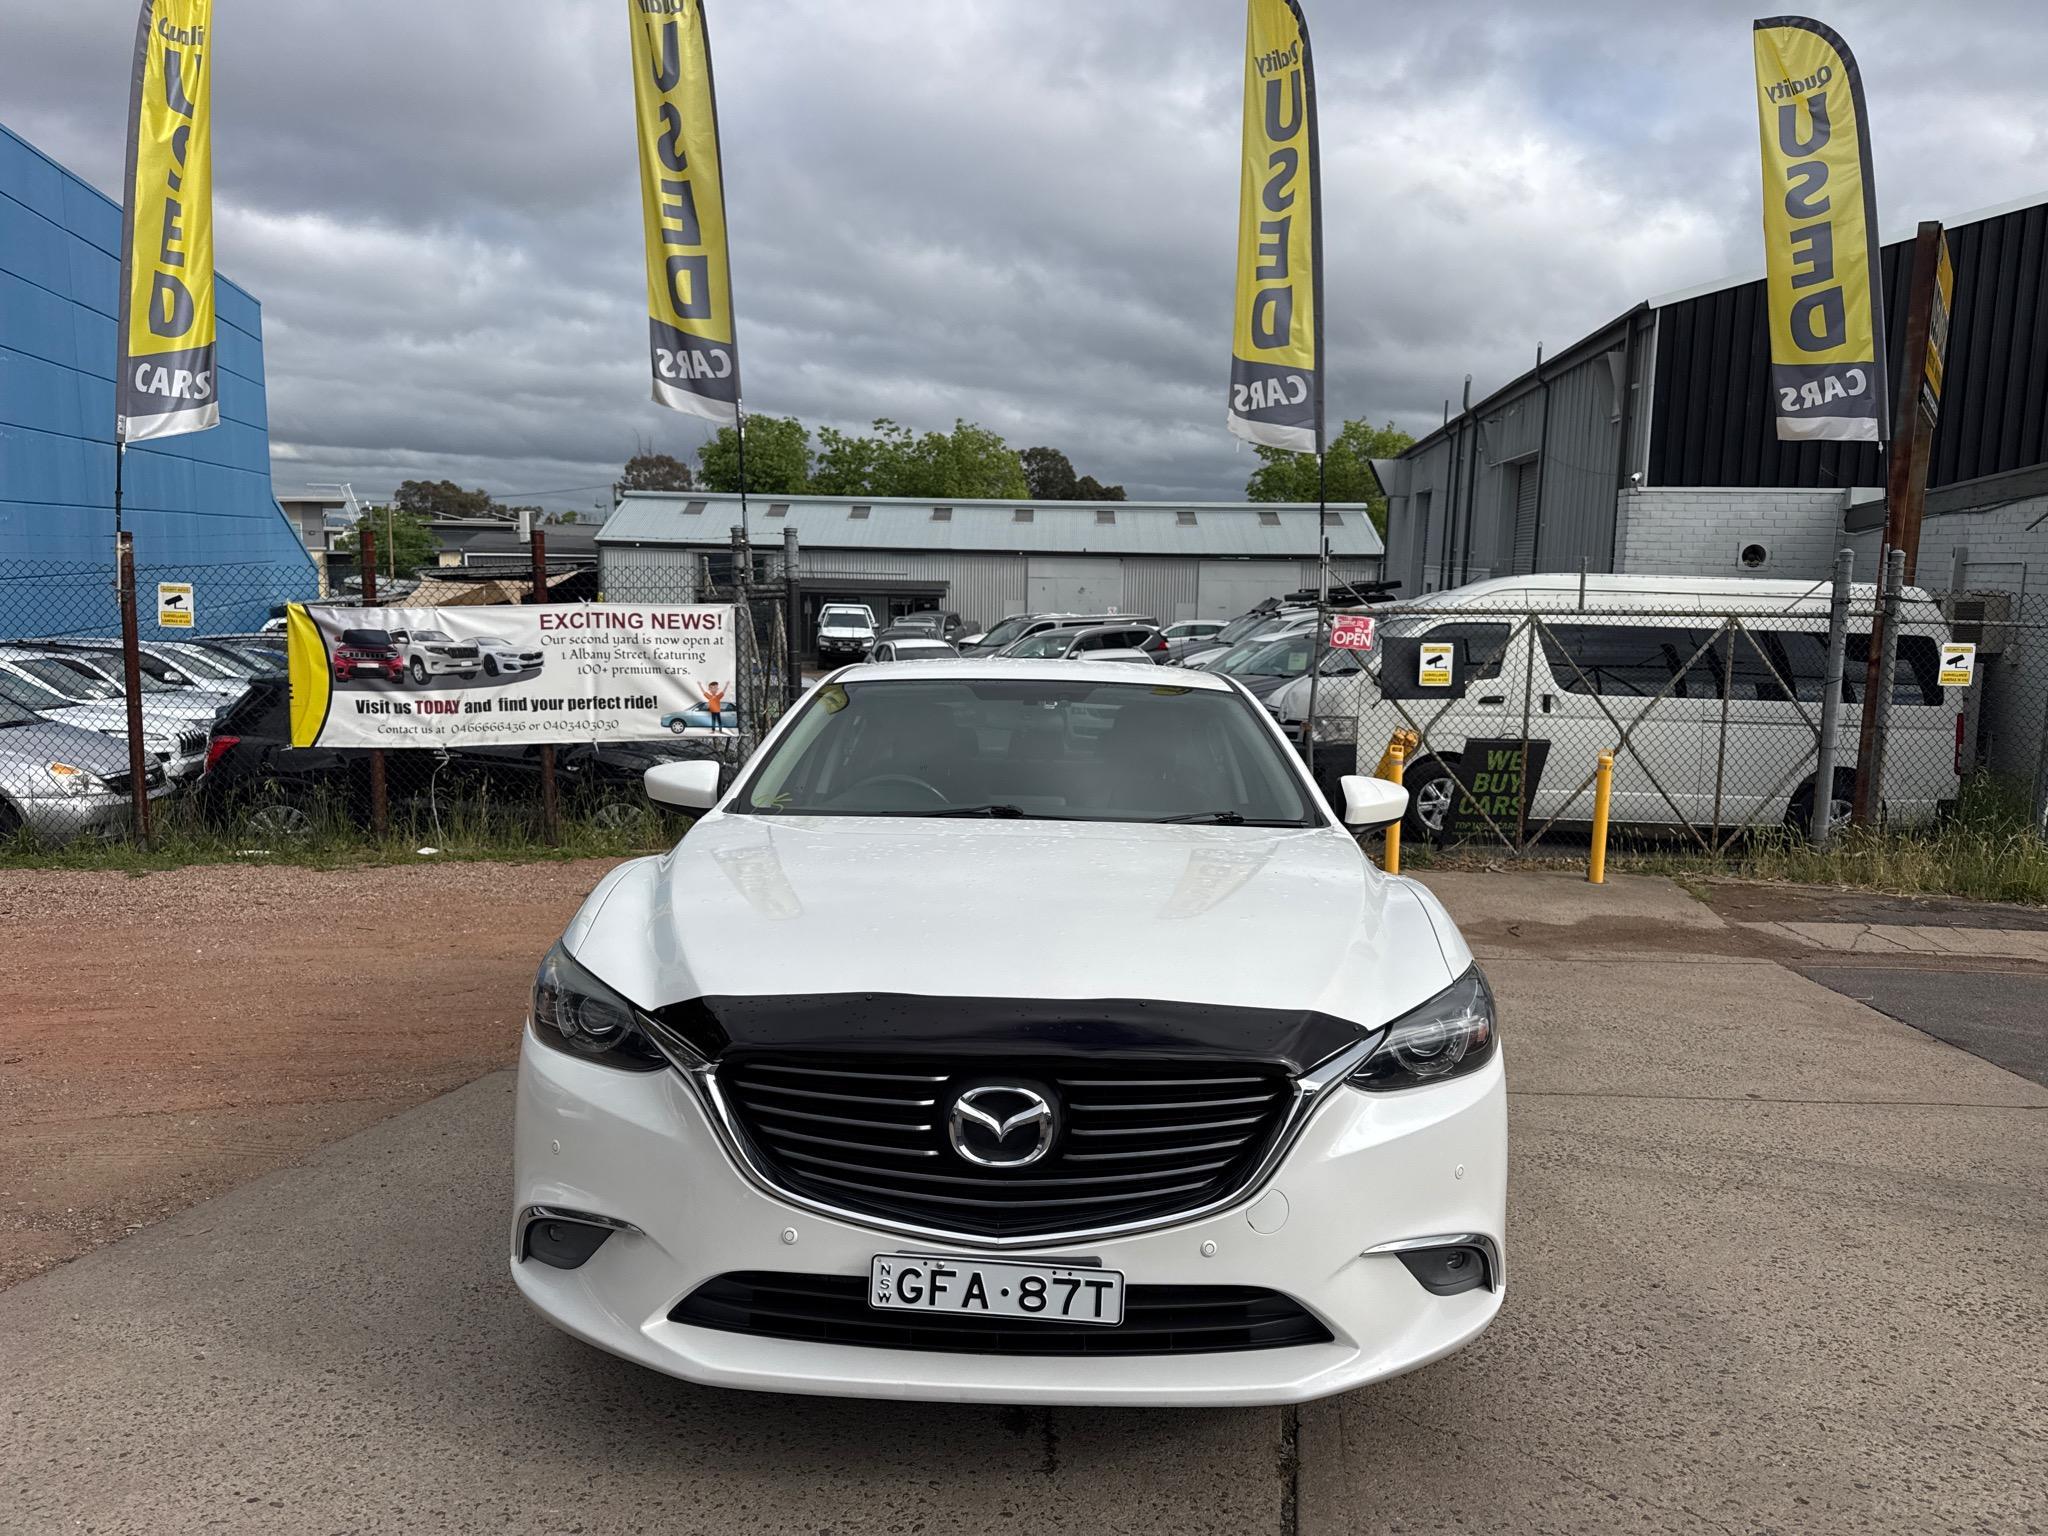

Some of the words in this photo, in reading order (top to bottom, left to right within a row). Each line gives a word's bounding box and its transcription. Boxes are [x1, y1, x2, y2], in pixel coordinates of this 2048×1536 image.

[134, 362, 212, 401] CARS
[539, 612, 644, 631] EXCITING
[651, 613, 723, 630] NEWS!
[540, 634, 566, 647] Our
[569, 633, 609, 645] second
[612, 633, 639, 648] yard
[642, 633, 652, 645] is
[655, 635, 680, 646] now
[683, 635, 710, 650] open
[713, 635, 725, 646] at
[1333, 630, 1372, 647] OPEN
[561, 651, 566, 660] 1
[569, 649, 611, 662] Albany
[653, 649, 706, 664] featuring
[577, 664, 607, 675] 100+
[612, 664, 662, 678] premium
[664, 665, 691, 675] cars.
[355, 699, 391, 714] Visit
[393, 702, 411, 715] us
[414, 699, 461, 715] TODAY
[464, 699, 492, 714] and
[498, 697, 528, 711] find
[532, 697, 564, 713] your
[567, 695, 621, 712] perfect
[624, 695, 658, 709] ride!
[377, 723, 418, 734] Contact
[436, 725, 445, 734] at
[528, 722, 541, 731] or
[543, 719, 619, 732] 0403403030
[1487, 750, 1522, 771] WE
[1472, 773, 1521, 794] BUY
[1458, 795, 1520, 816] CARS
[877, 1263, 893, 1304] NSW
